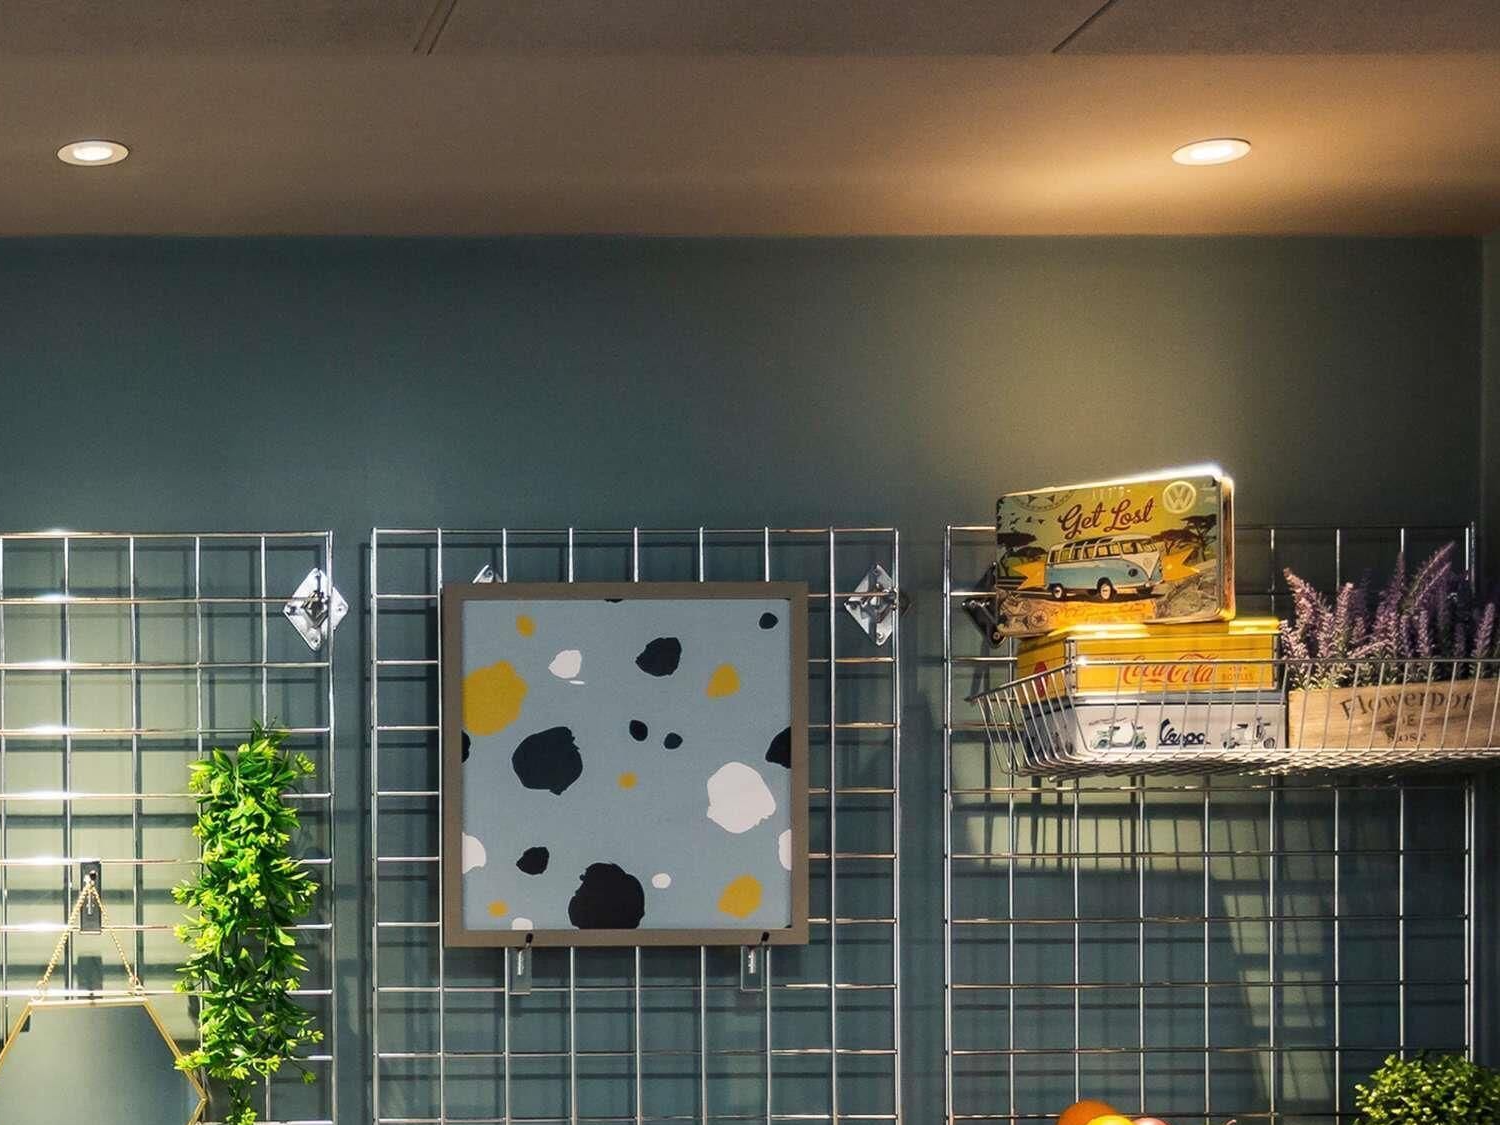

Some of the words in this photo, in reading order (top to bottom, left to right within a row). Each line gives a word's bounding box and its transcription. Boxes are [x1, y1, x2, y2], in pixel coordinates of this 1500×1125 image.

[1057, 502, 1106, 540] Get
[1103, 496, 1156, 533] Lost
[1339, 690, 1474, 720] Flowerpot
